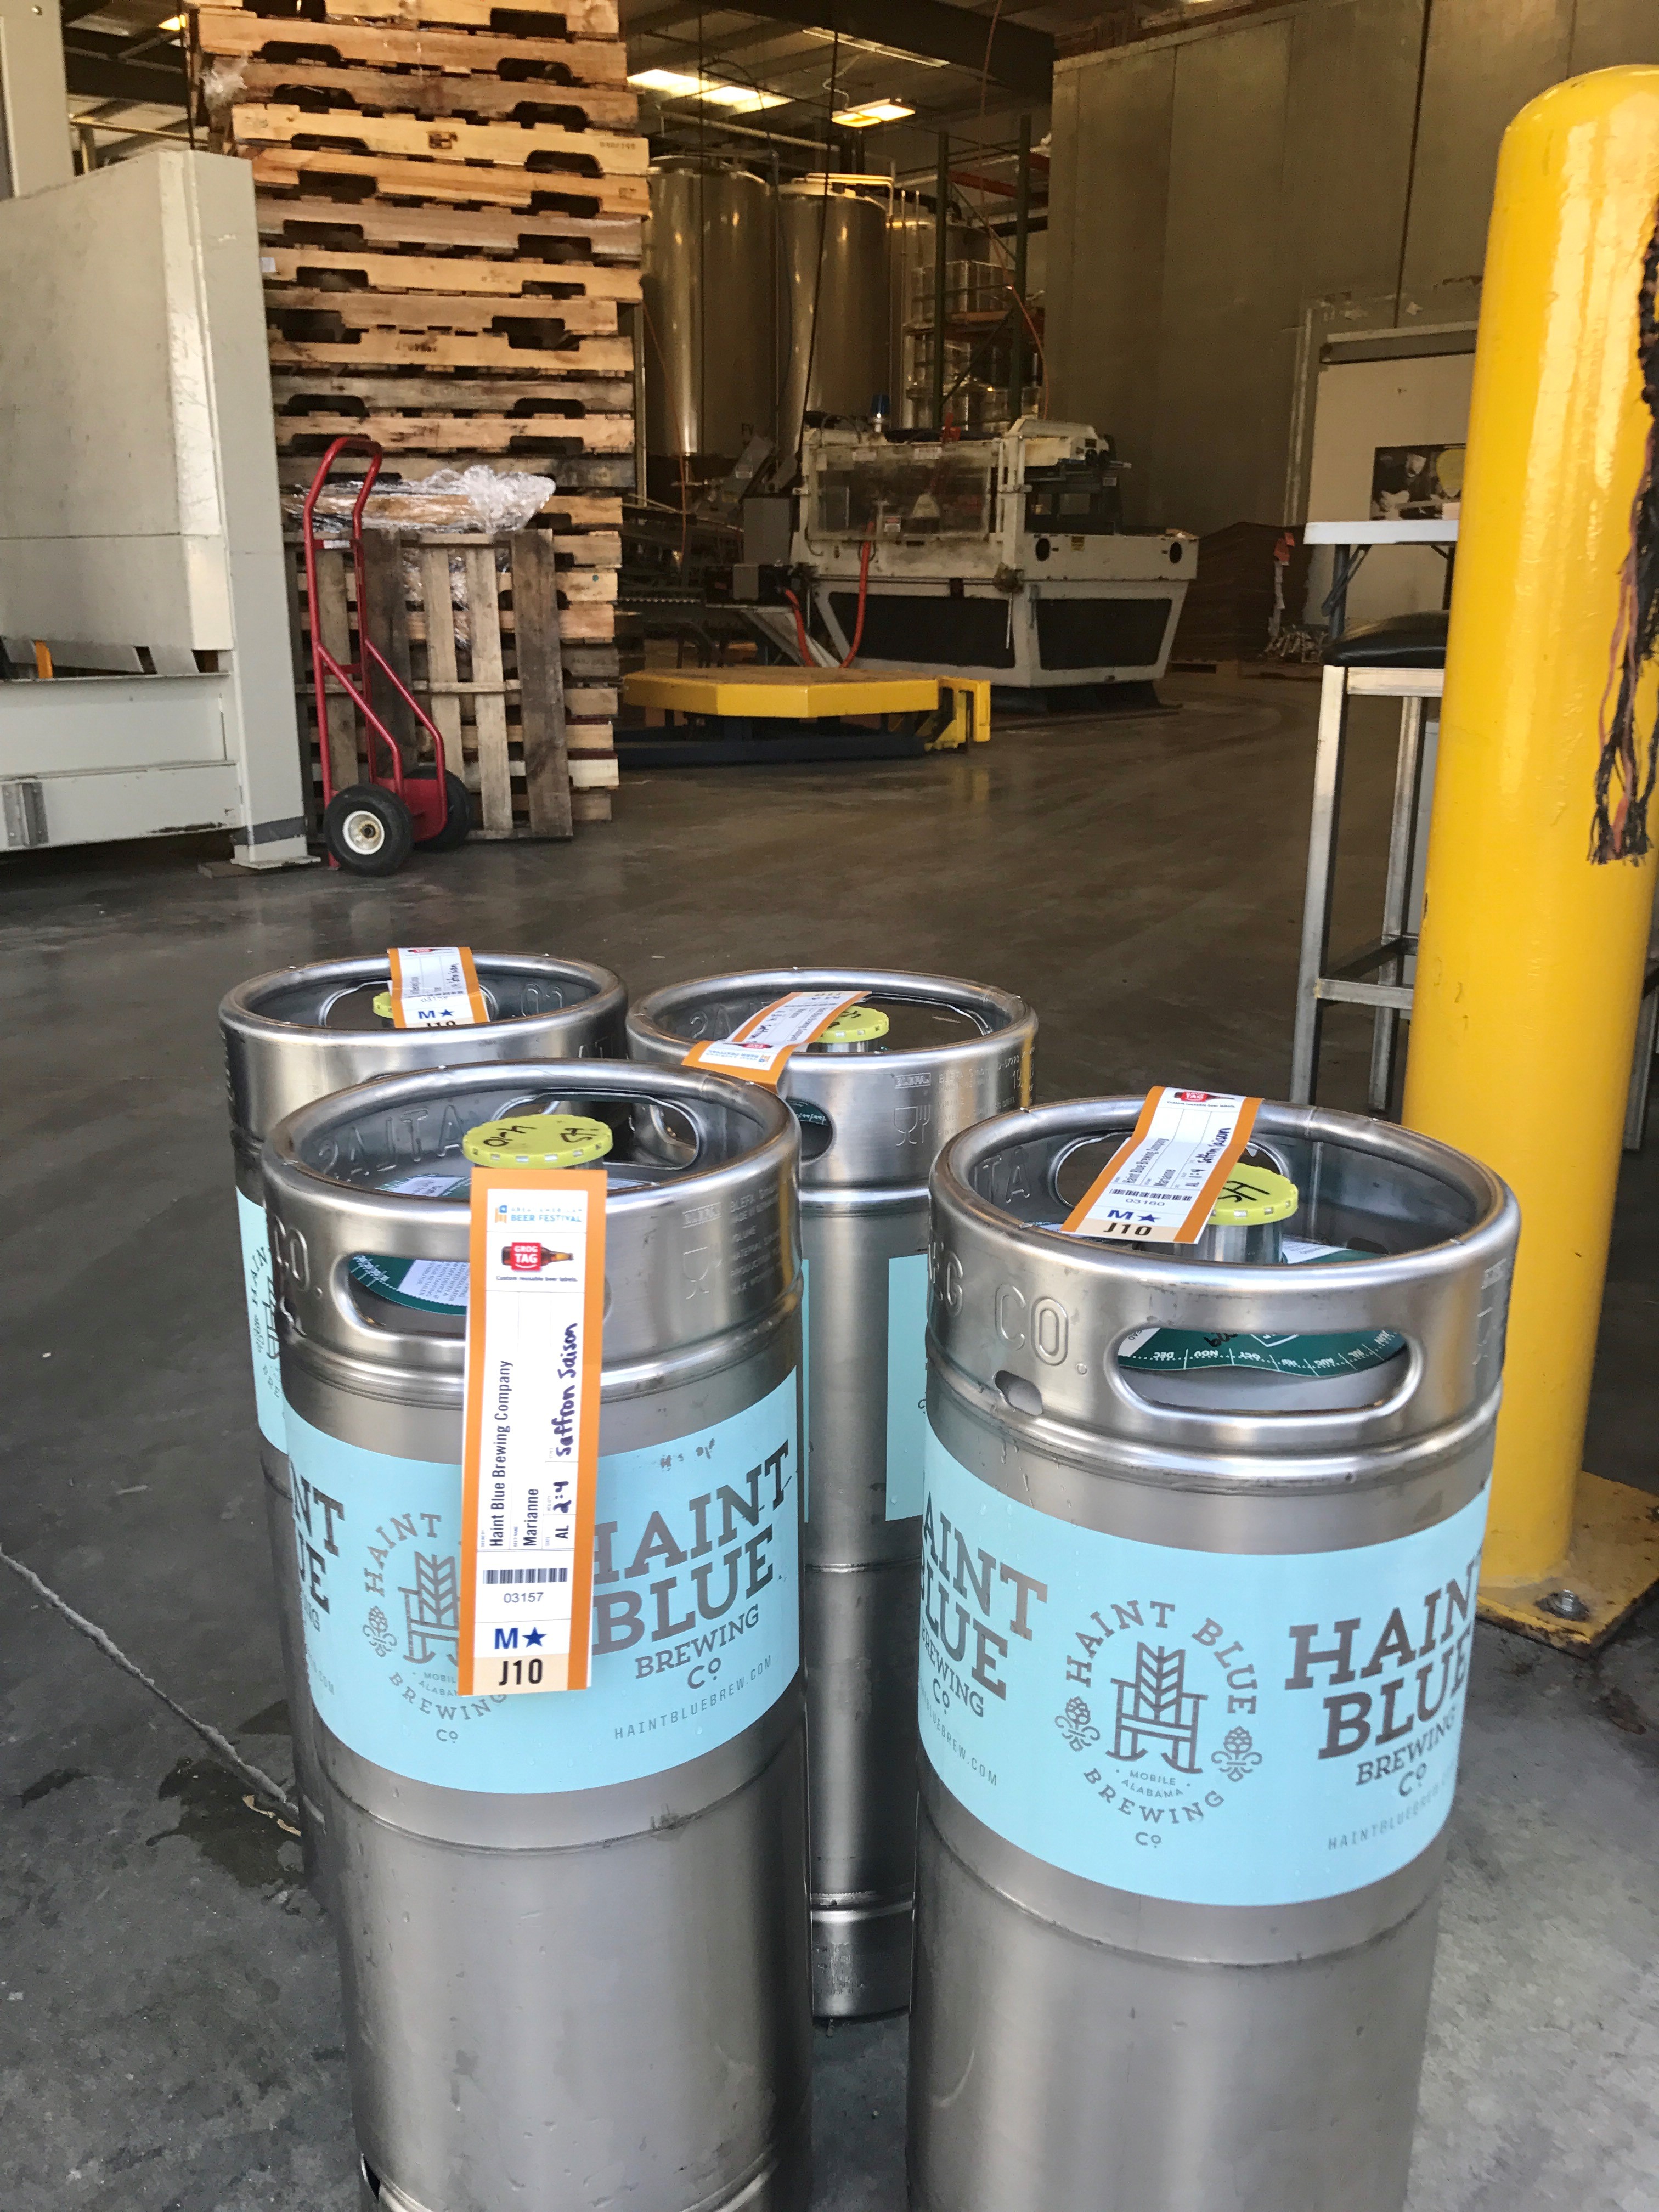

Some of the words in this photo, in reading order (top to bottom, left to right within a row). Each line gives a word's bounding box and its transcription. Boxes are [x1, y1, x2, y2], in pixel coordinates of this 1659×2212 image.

[418, 1010, 436, 1019] M
[539, 1214, 582, 1222] FESTIVAL
[1107, 1210, 1135, 1220] M
[1125, 1198, 1166, 1207] 03160
[1103, 1222, 1153, 1236] J10
[514, 1253, 538, 1264] TAG
[557, 1322, 578, 1379] Saison
[1240, 1351, 1261, 1361] OCT
[494, 1361, 514, 1420] Company
[551, 1385, 575, 1457] Saffron
[492, 1425, 511, 1477] Brewing
[490, 1482, 506, 1510] Blue
[489, 1514, 505, 1547] Haint
[522, 1488, 539, 1547] Marianne
[555, 1525, 569, 1539] AL
[364, 1512, 442, 1597] HAINT
[922, 1491, 1048, 1642] AINT
[503, 1592, 544, 1604] 03157
[591, 1523, 774, 1656] BLUE
[1284, 1550, 1480, 1690] HAIN
[494, 1627, 519, 1650] M
[635, 1602, 759, 1680] BREWING
[498, 1658, 543, 1686] J10
[1065, 1599, 1176, 1688] HAINT
[1190, 1617, 1259, 1716] BLUE
[418, 1680, 458, 1696] ALABA
[423, 1671, 457, 1684] MOBIL
[1318, 1621, 1472, 1760] BLUE
[388, 1671, 509, 1722] BREWING
[614, 1655, 772, 1740] HAINTBLUEBREW.COM
[1356, 1705, 1457, 1786] BREWING
[1121, 1778, 1184, 1799] ALABAMA
[1129, 1769, 1177, 1786] MOBILE
[1083, 1767, 1226, 1825] BREWING
